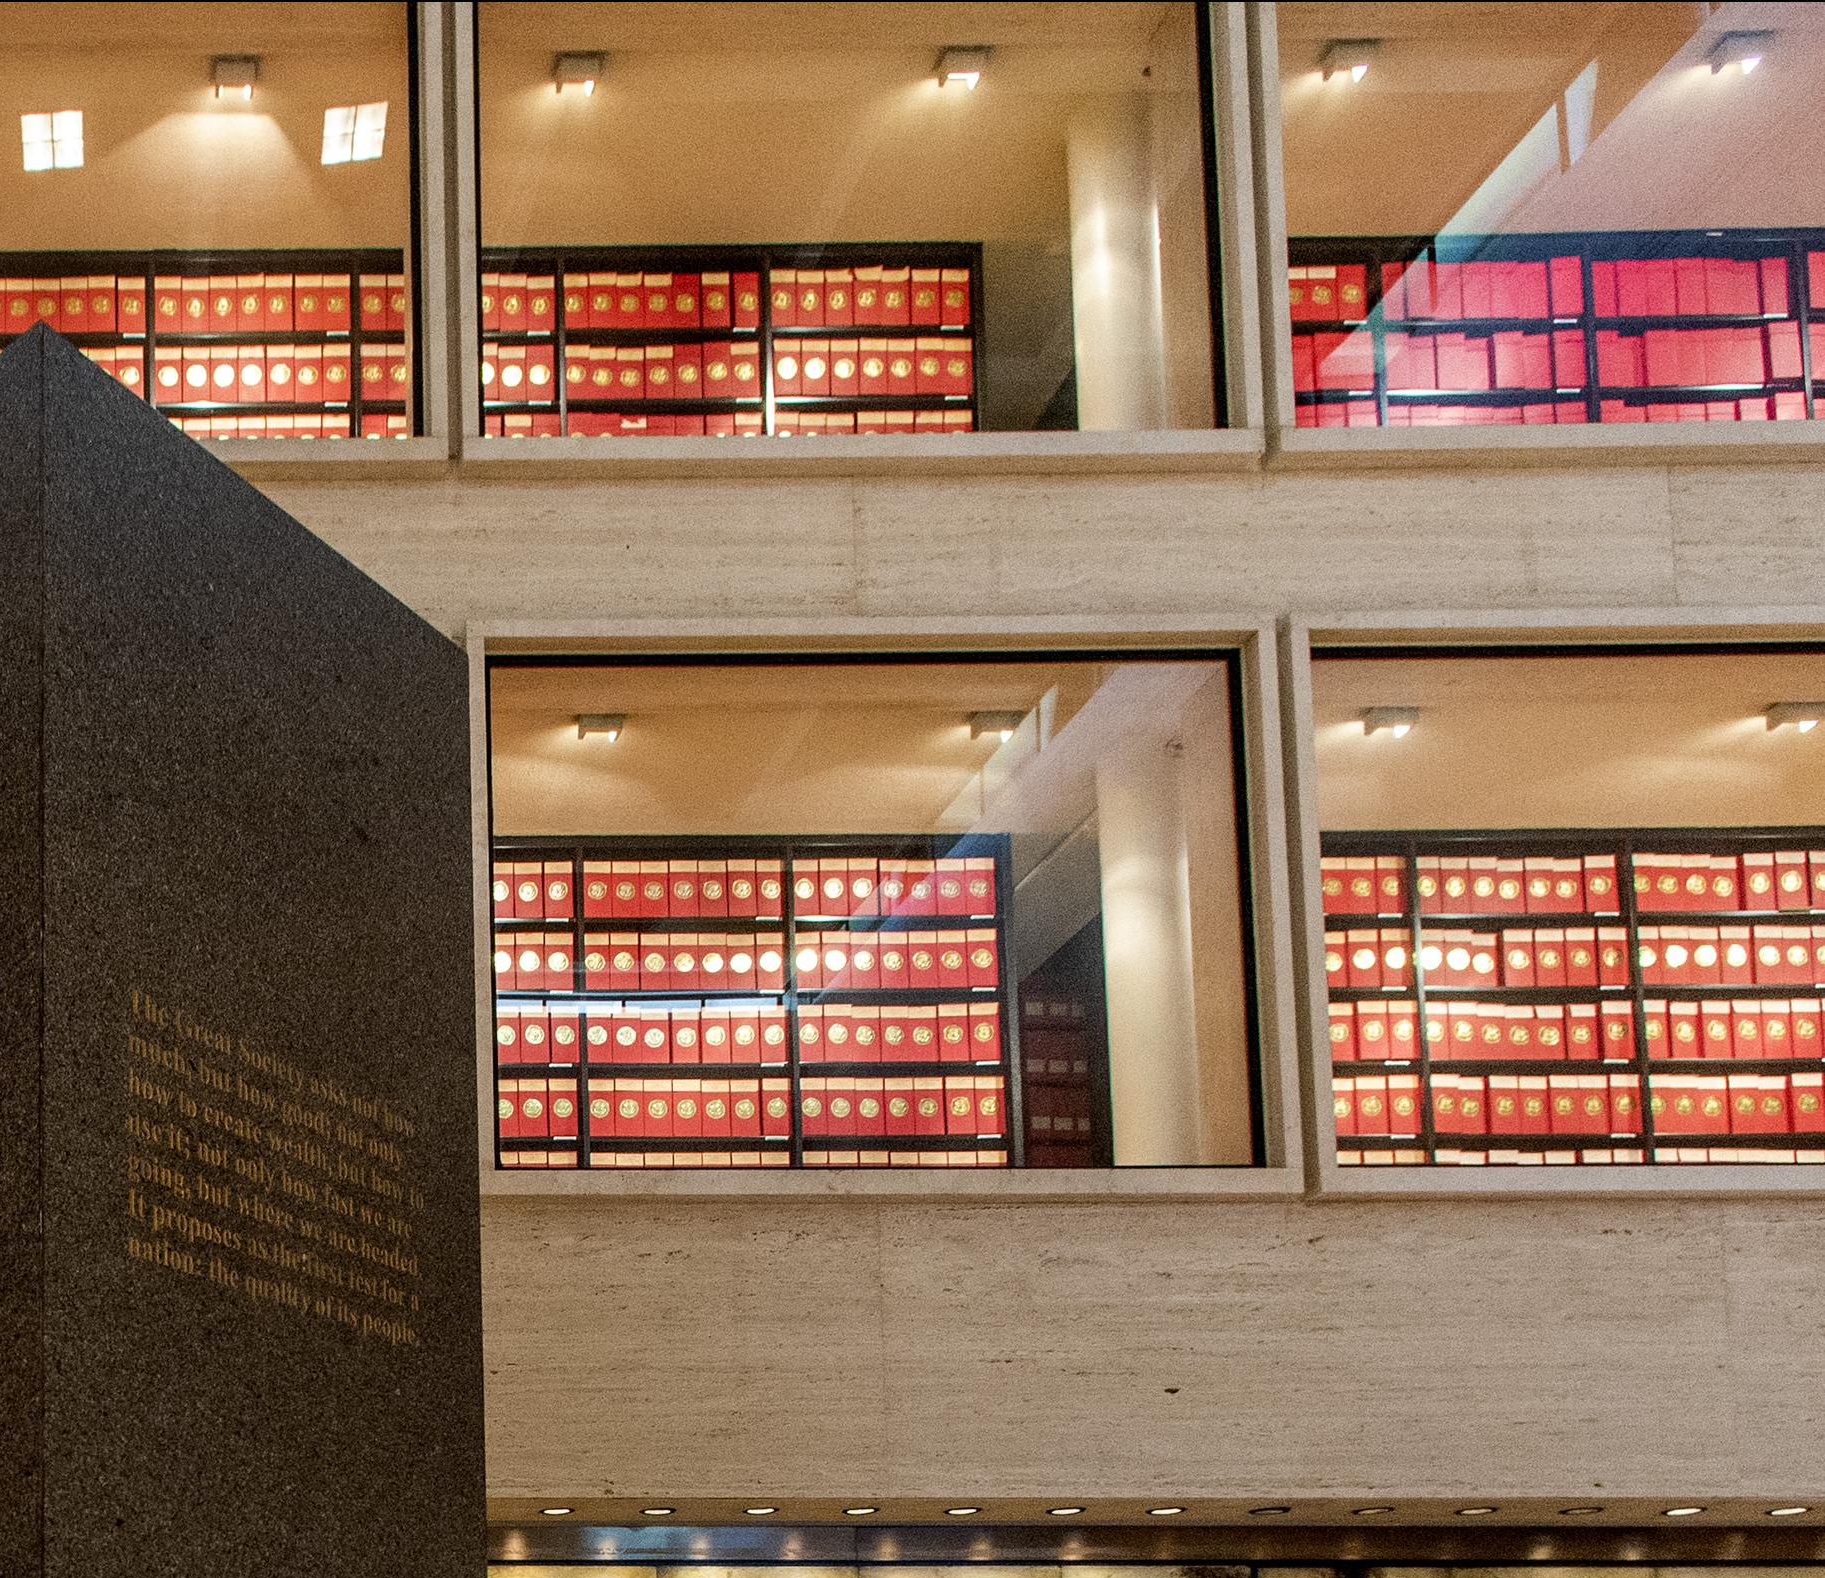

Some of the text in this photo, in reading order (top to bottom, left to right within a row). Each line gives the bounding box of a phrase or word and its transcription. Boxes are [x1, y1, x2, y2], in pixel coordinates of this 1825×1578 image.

[130, 989, 414, 1138] The Great Society asks not how
[199, 1057, 231, 1092] but
[237, 1075, 275, 1112] how
[337, 1122, 364, 1148] not
[369, 1139, 402, 1172] only
[126, 1114, 413, 1239] use it; not only how fast we are
[129, 1066, 173, 1106] how
[179, 1090, 197, 1118] to
[204, 1104, 262, 1143] create
[339, 1152, 365, 1186] but
[372, 1167, 403, 1201] how
[410, 1187, 424, 1210] to
[128, 1156, 191, 1200] going,
[198, 1174, 231, 1207] but
[237, 1193, 293, 1228] where
[301, 1219, 322, 1239] we
[329, 1231, 356, 1253] are
[128, 1187, 144, 1218] It
[153, 1204, 241, 1249] proposes
[249, 1238, 268, 1259] as
[273, 1242, 301, 1268] the
[349, 1267, 377, 1295] test
[382, 1278, 405, 1305] for
[411, 1294, 420, 1311] a
[209, 1257, 239, 1287] the
[247, 1276, 311, 1313] quality
[315, 1295, 334, 1318] of
[338, 1298, 359, 1327] its
